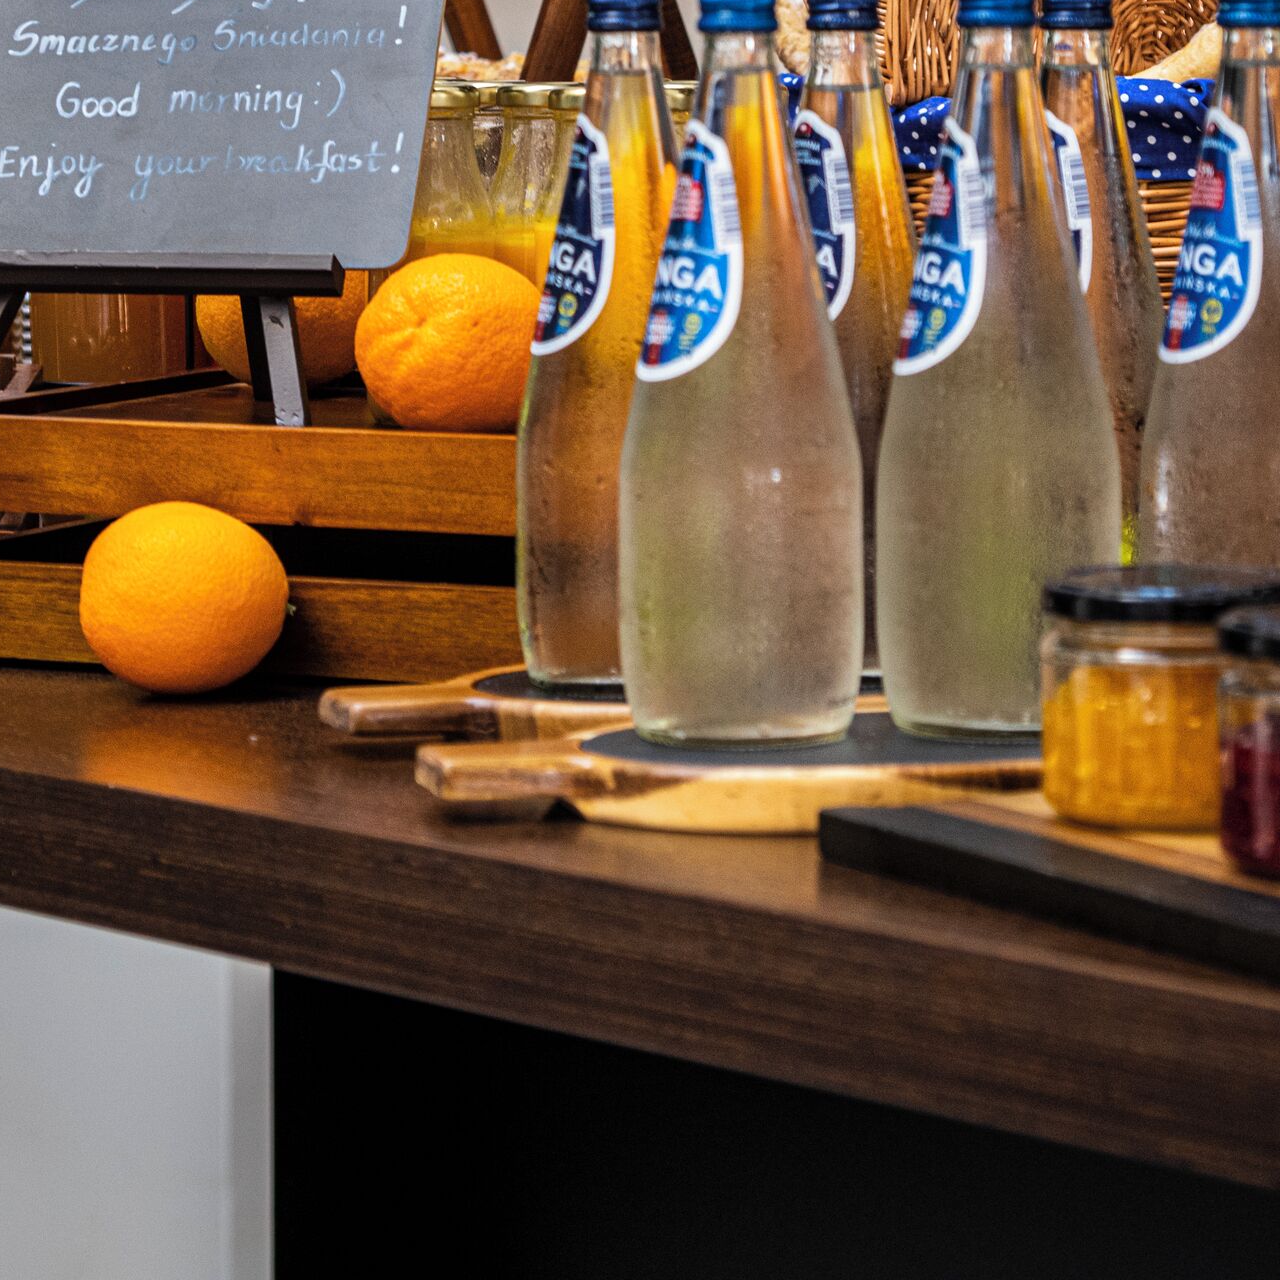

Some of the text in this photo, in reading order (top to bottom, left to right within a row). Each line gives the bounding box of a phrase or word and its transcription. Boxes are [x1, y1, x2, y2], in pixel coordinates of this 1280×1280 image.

[8, 20, 197, 65] Smacznego
[55, 81, 140, 119] Good
[130, 152, 217, 201] your
